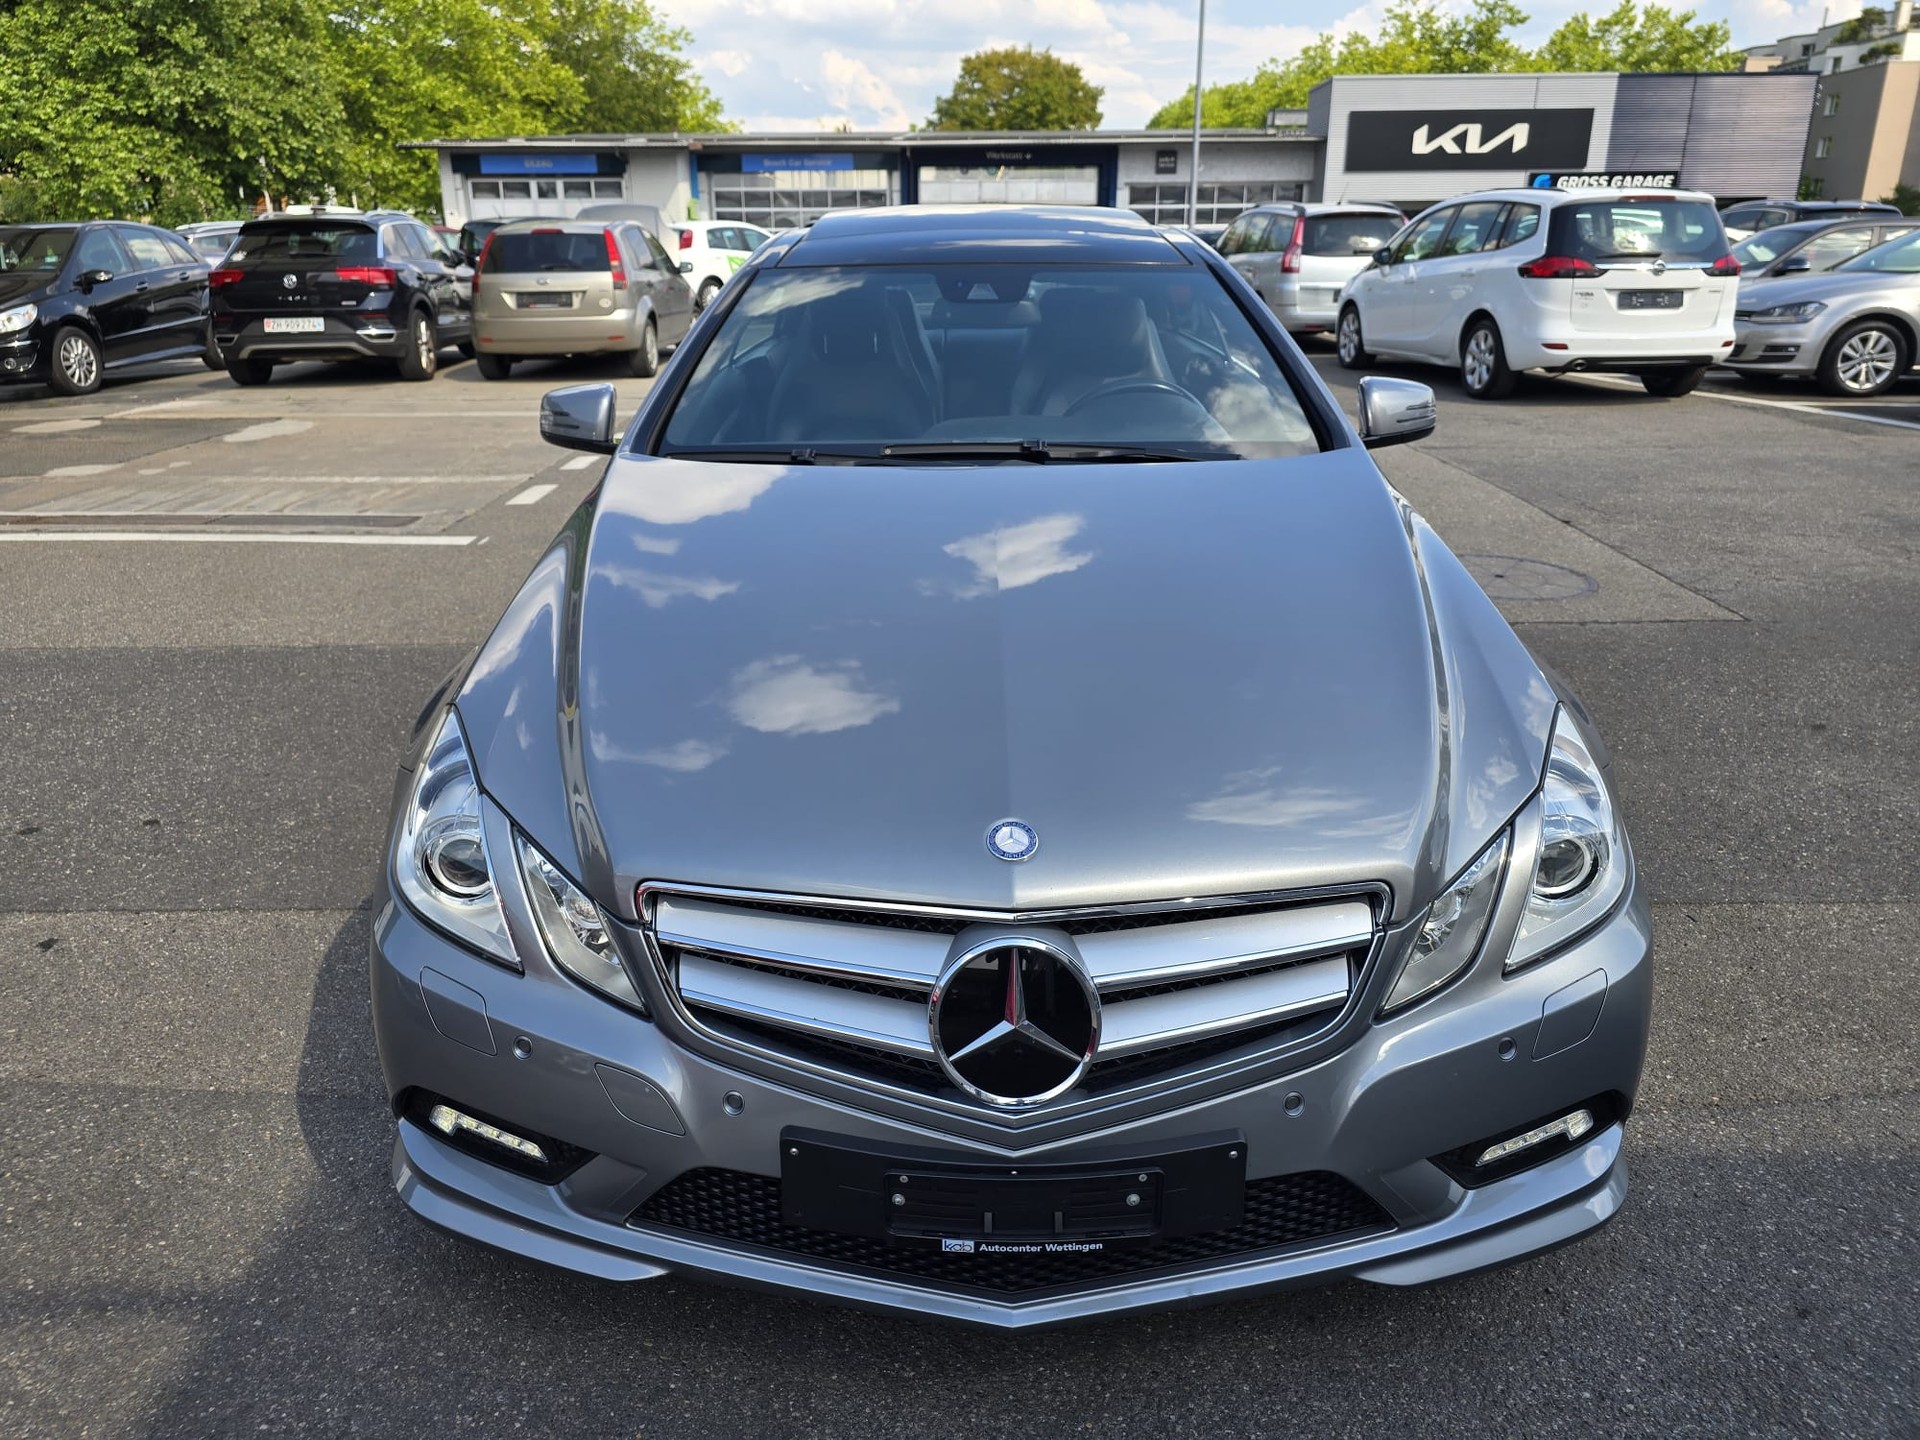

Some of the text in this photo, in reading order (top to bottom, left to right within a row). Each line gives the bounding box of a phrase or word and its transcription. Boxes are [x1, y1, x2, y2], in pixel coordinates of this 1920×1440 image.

[1412, 123, 1530, 154] KIA
[1556, 174, 1675, 188] GROSS GARAGE
[979, 1243, 1042, 1252] Autocenter
[1045, 1243, 1103, 1252] Wettingen
